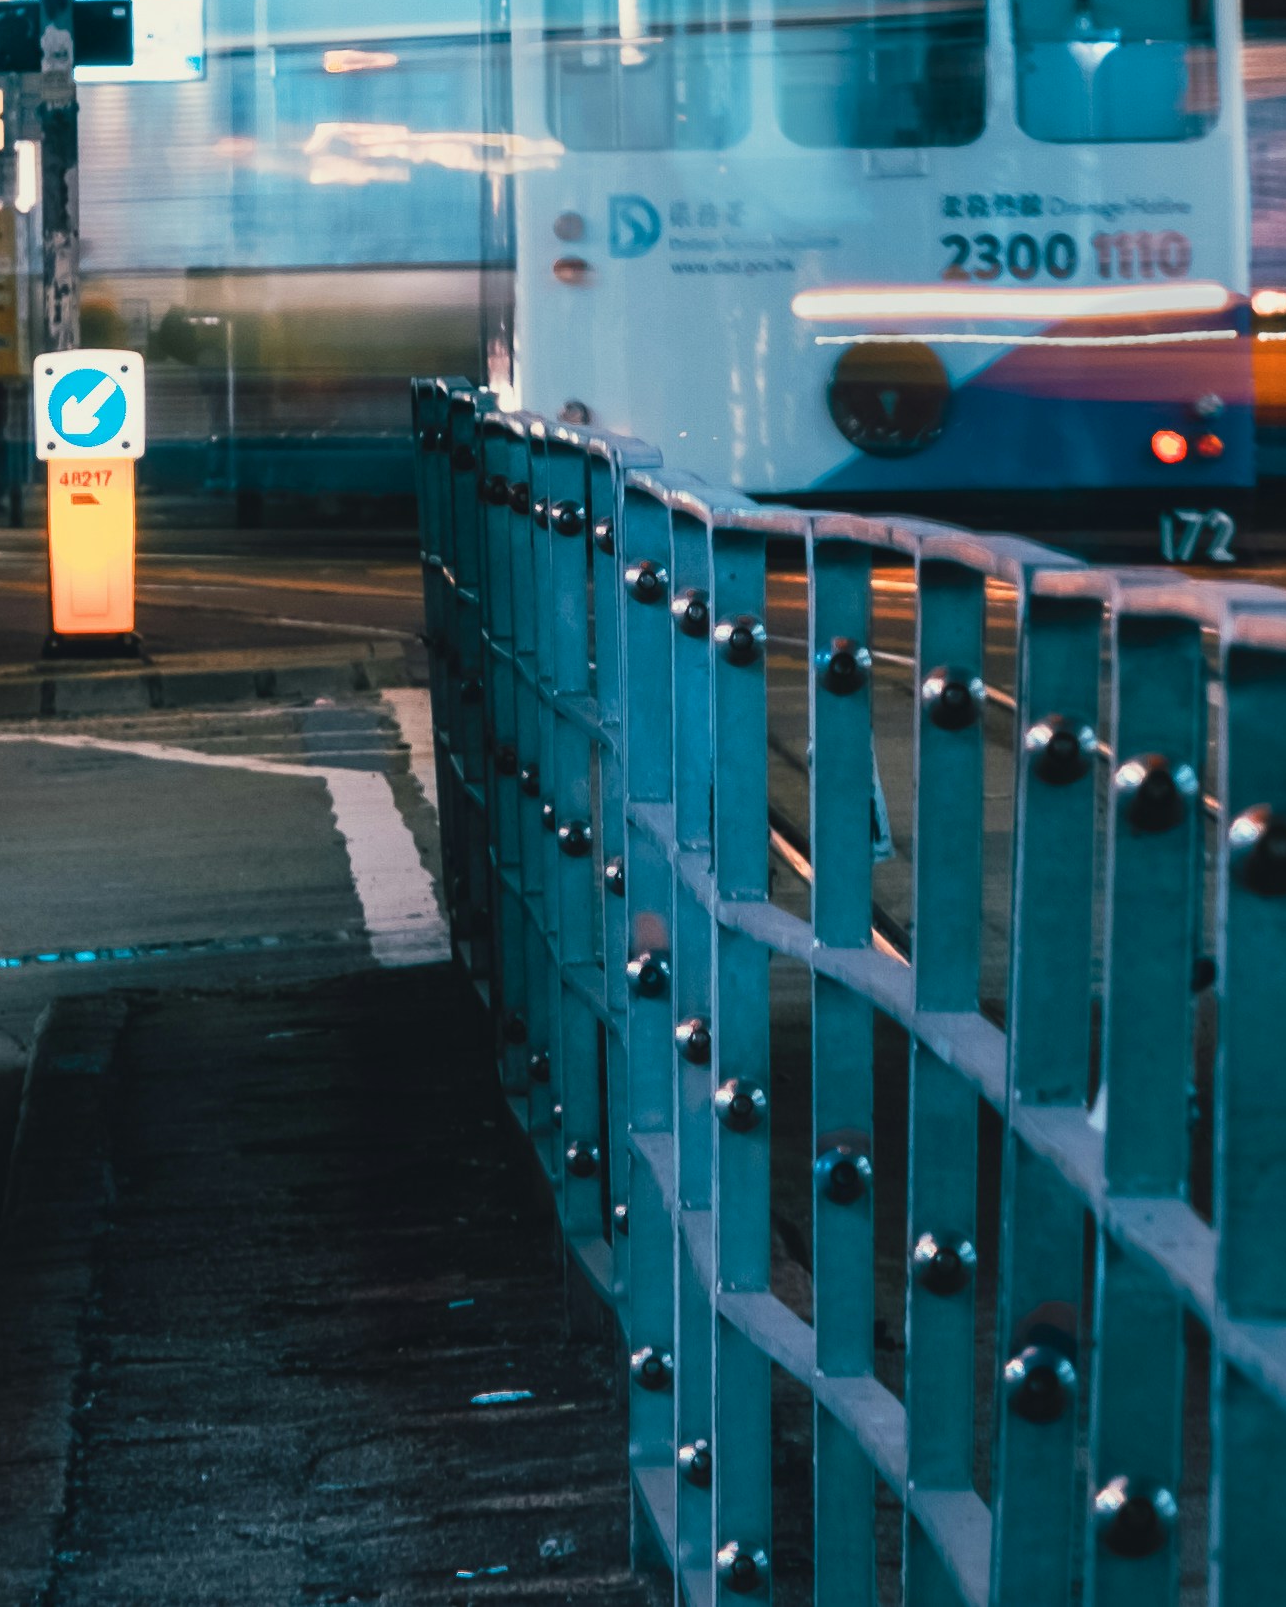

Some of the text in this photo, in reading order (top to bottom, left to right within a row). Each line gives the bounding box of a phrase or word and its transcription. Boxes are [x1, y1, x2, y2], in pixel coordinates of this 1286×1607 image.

[940, 230, 1193, 281] 2300 1110
[1159, 506, 1237, 562] 172
